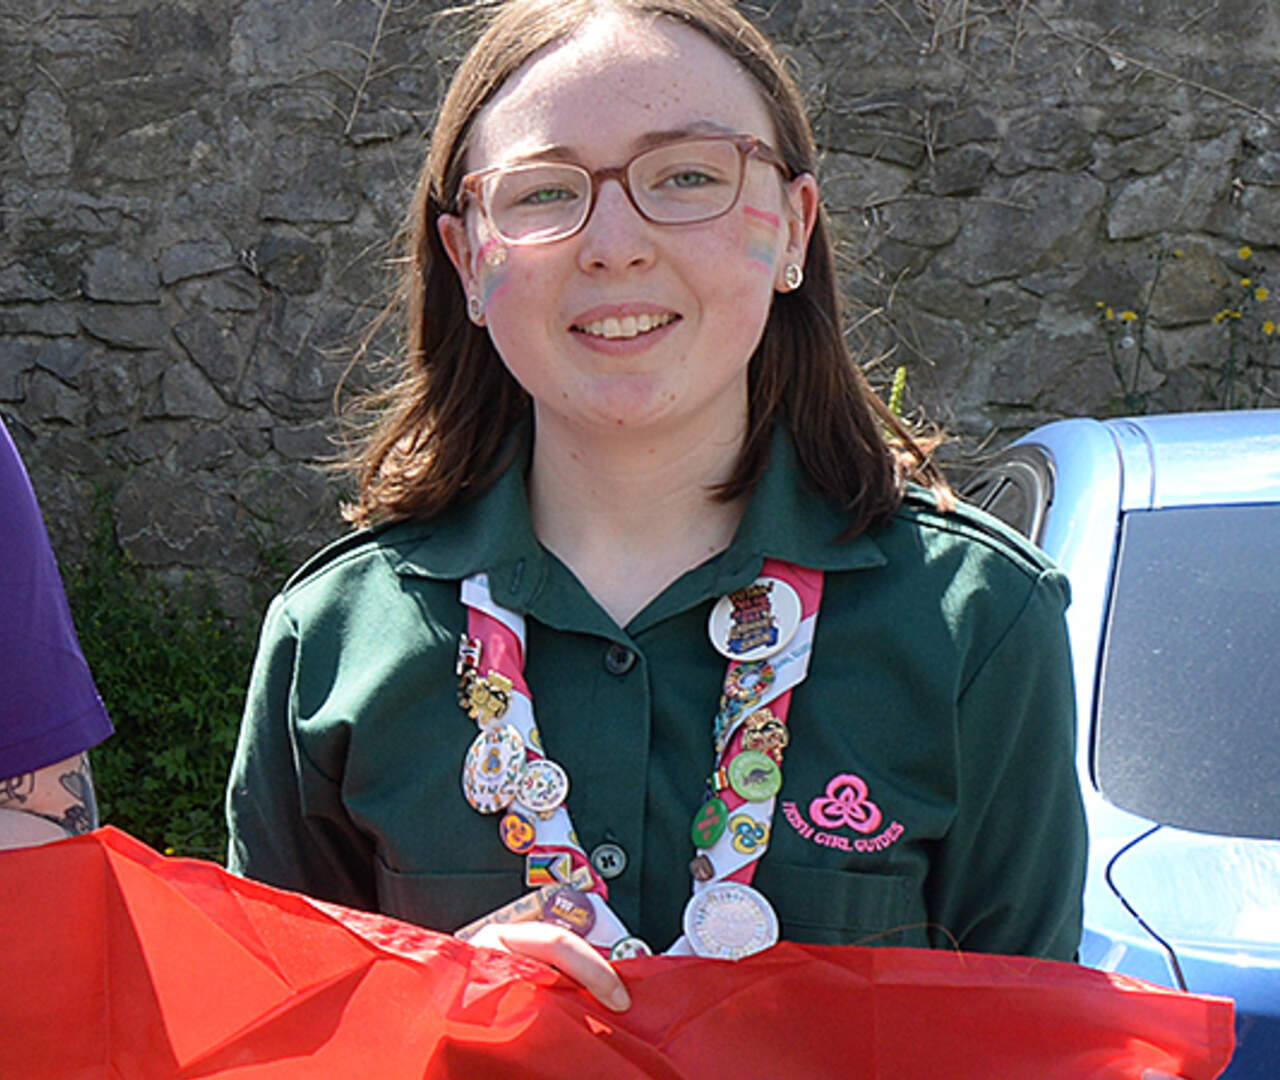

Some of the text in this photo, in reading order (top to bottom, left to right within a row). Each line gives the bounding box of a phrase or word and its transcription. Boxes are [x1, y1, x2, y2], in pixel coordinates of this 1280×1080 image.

[781, 801, 906, 853] IRISH GIRL GUIDES
